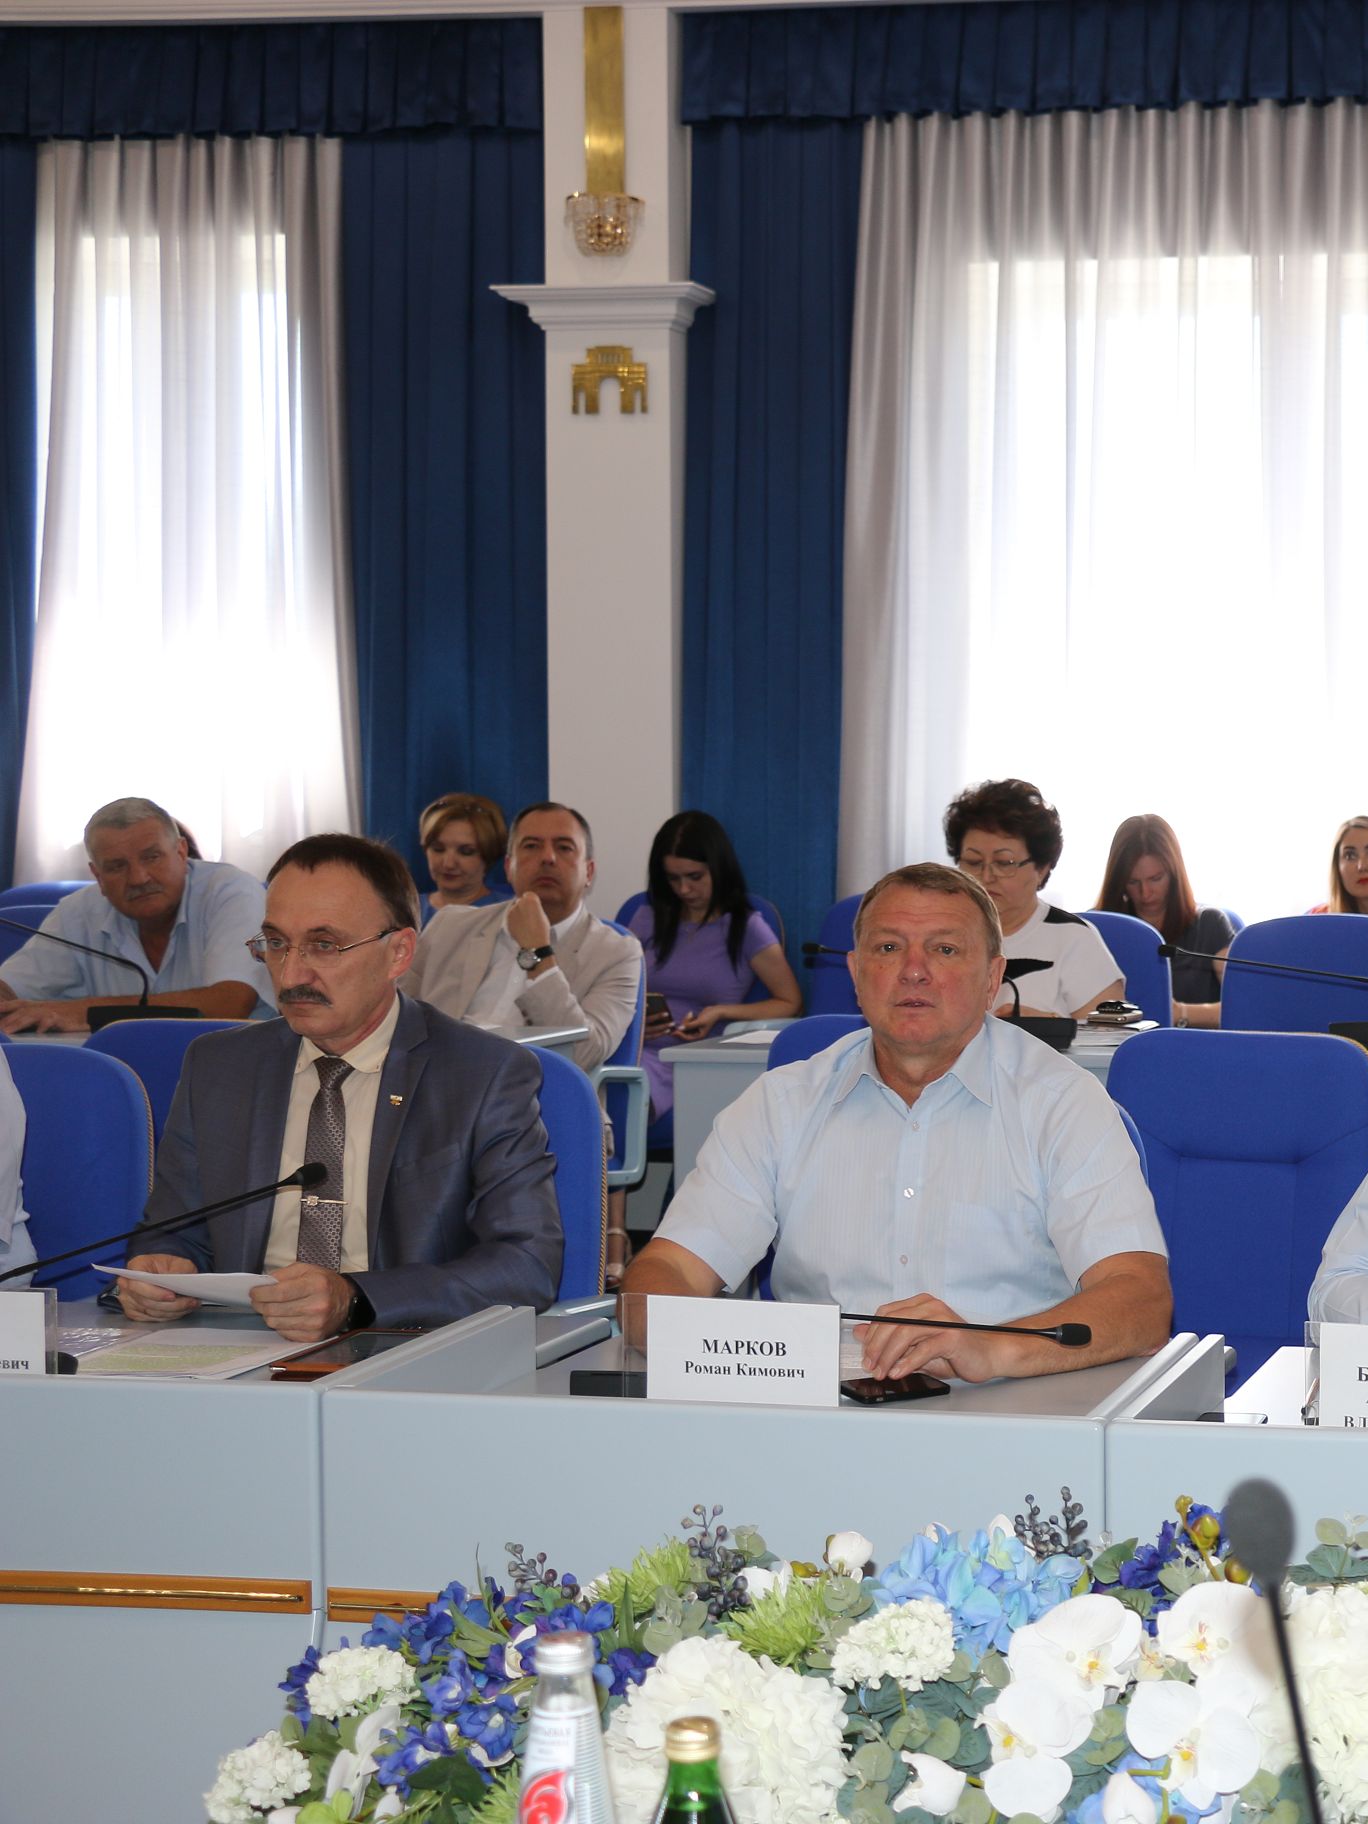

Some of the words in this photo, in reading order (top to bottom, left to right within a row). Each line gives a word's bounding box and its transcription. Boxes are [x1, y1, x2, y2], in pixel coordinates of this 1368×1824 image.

[702, 1338, 787, 1357] МАРКОВ
[0, 1359, 29, 1370] вич
[684, 1360, 731, 1376] Роман
[736, 1362, 805, 1379] Кимович
